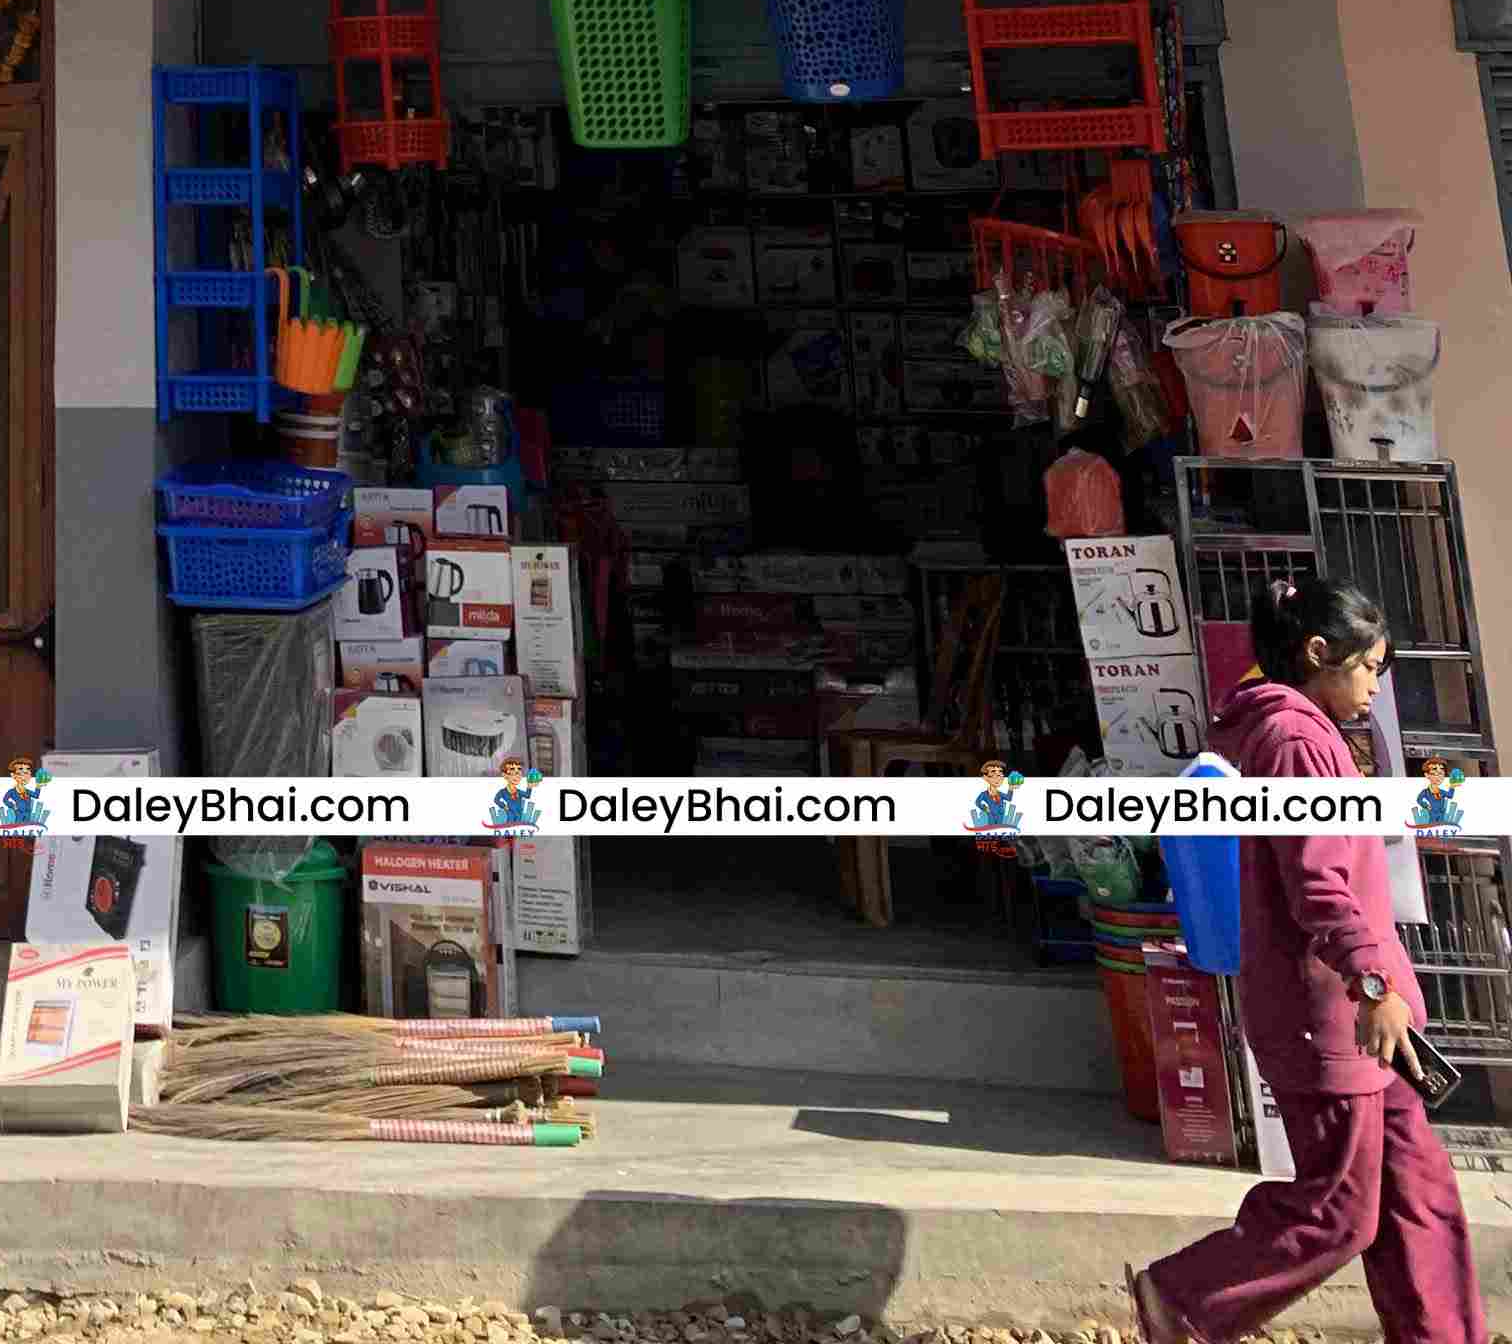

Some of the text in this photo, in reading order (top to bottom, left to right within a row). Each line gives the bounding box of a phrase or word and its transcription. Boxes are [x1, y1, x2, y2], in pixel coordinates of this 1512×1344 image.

[1071, 543, 1137, 560] TORAN
[1095, 663, 1160, 678] TORAN
[374, 856, 469, 872] HALOGEN HEATER
